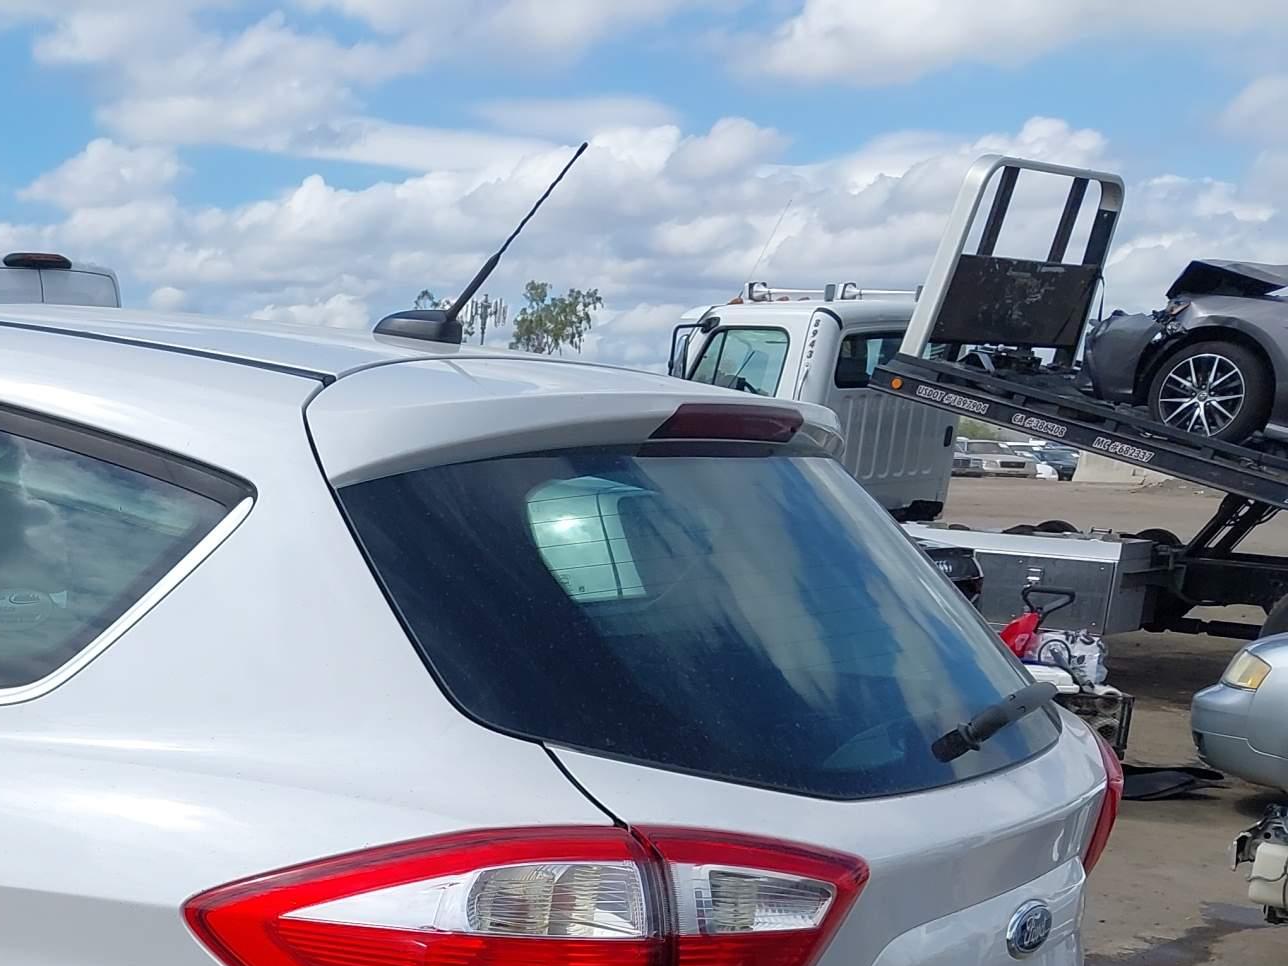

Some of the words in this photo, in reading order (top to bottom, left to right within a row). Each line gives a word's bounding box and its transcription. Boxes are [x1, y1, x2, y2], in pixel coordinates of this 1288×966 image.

[806, 319, 821, 359] 8943
[916, 385, 946, 401] USDOT
[1012, 413, 1025, 425] CA
[1092, 436, 1111, 450] MC
